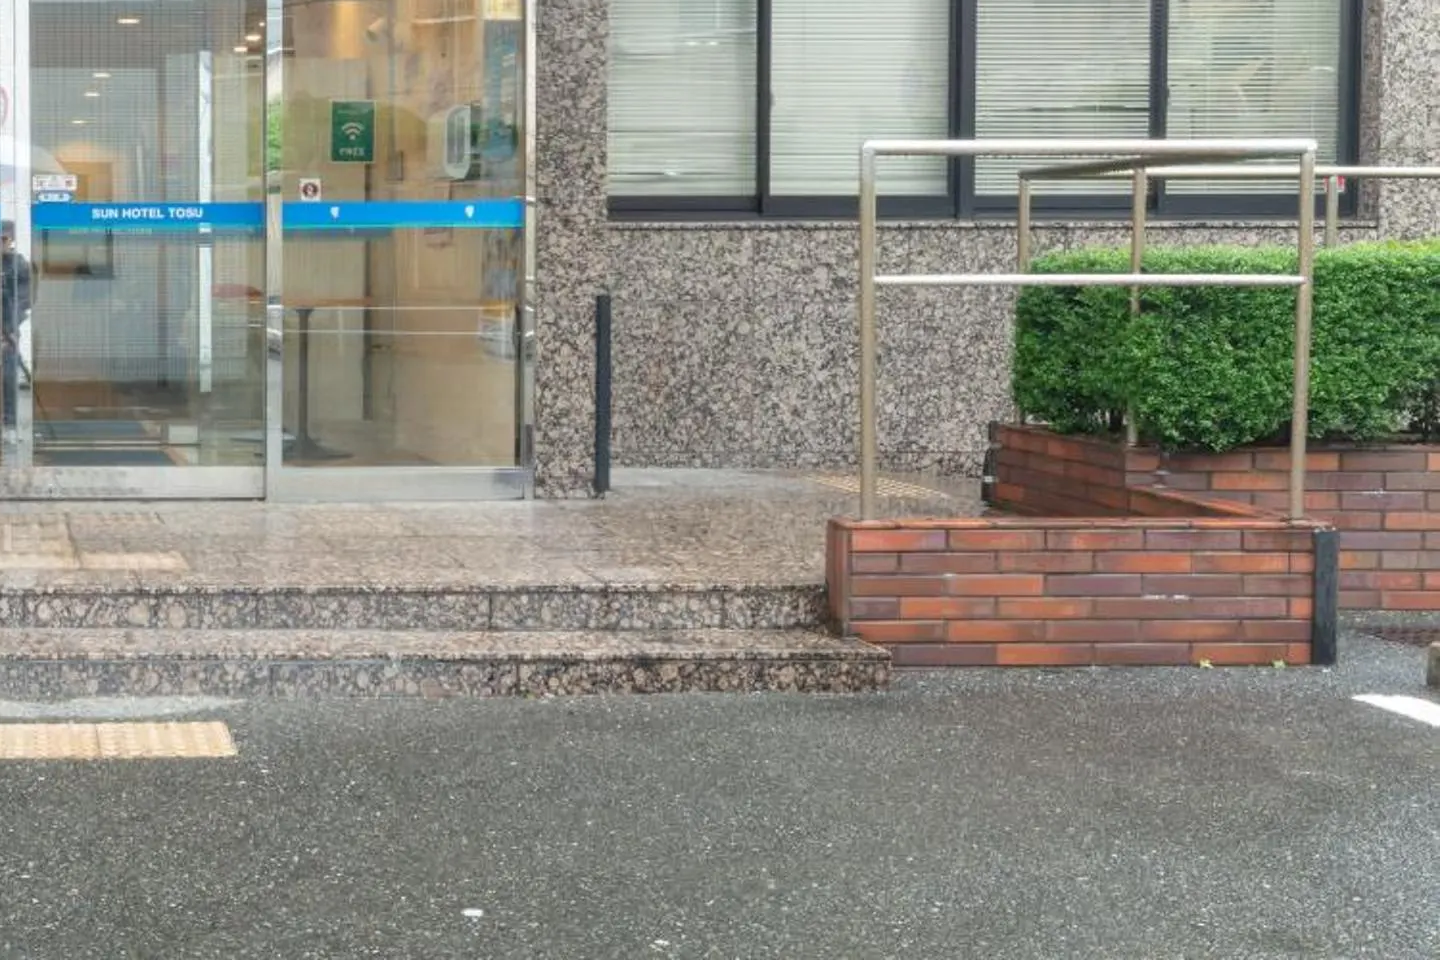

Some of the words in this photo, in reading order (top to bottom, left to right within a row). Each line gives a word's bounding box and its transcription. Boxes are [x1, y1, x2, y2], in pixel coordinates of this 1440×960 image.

[91, 207, 119, 219] SUN
[122, 207, 165, 219] HOTEL
[168, 206, 204, 219] TOSU
